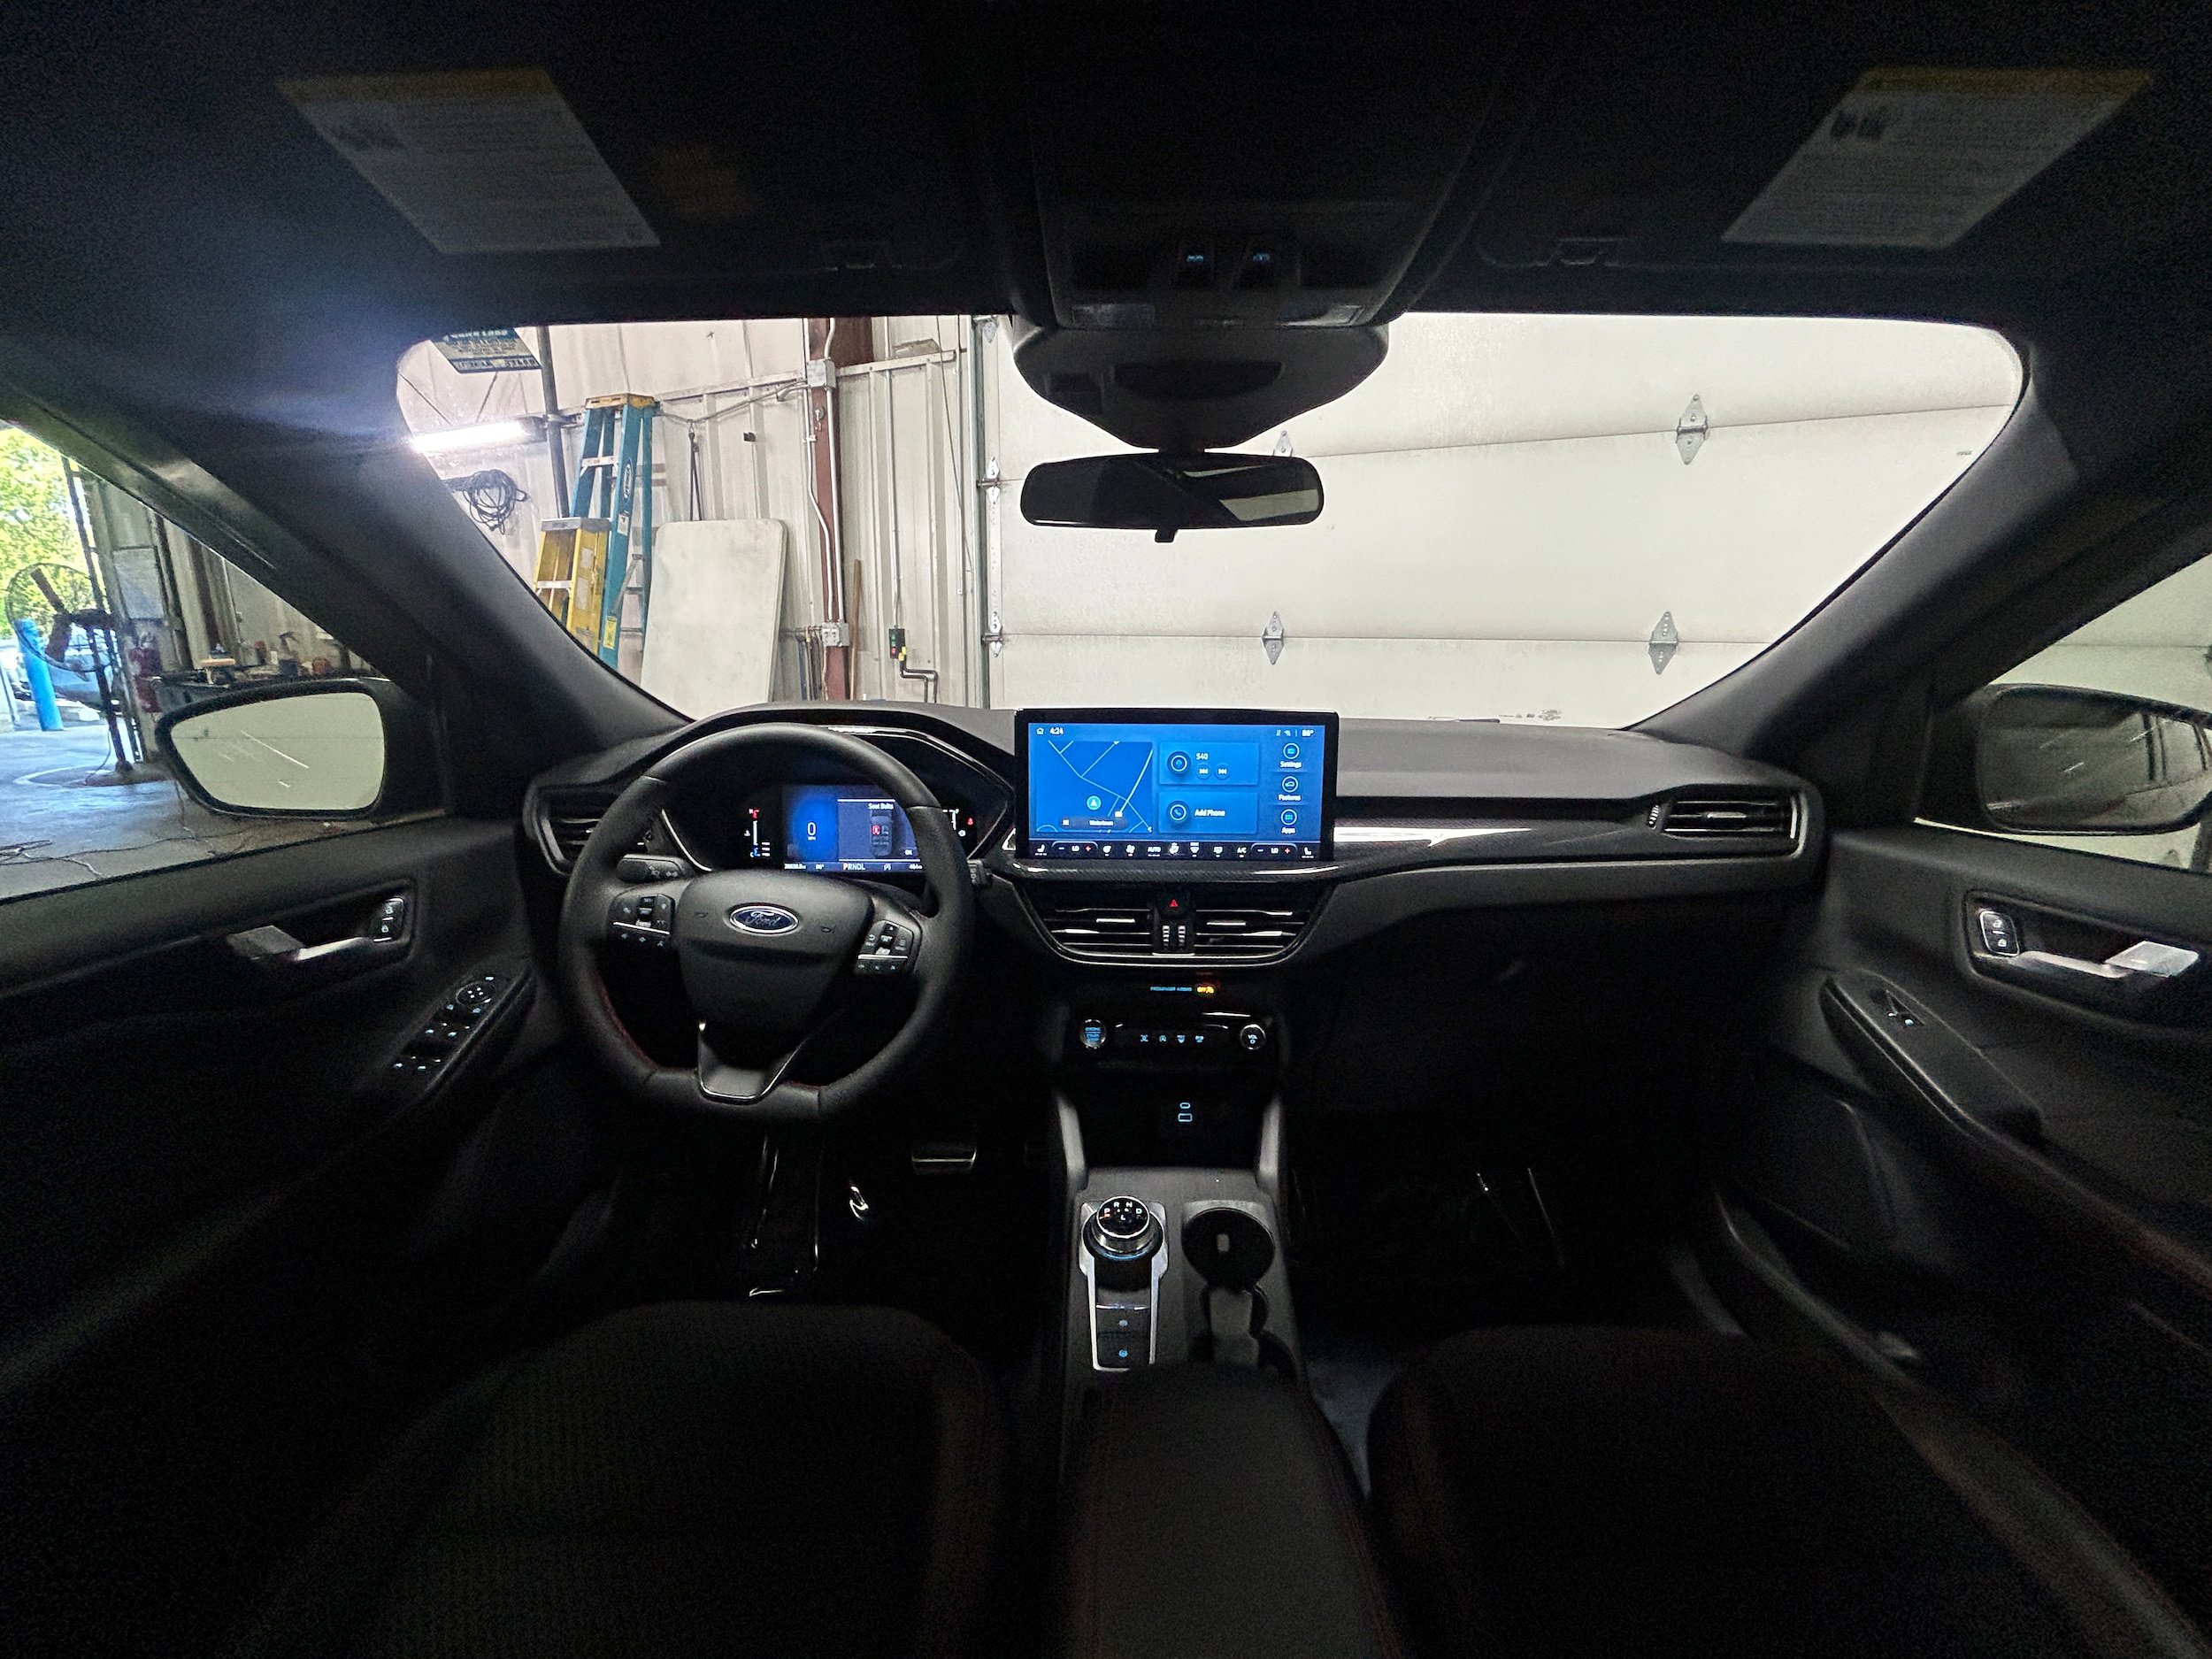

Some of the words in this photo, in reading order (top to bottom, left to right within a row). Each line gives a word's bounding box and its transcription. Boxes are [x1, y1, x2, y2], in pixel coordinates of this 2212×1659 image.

[1279, 760, 1302, 769] Settings
[807, 821, 817, 836] 0
[745, 910, 781, 926] Ford
